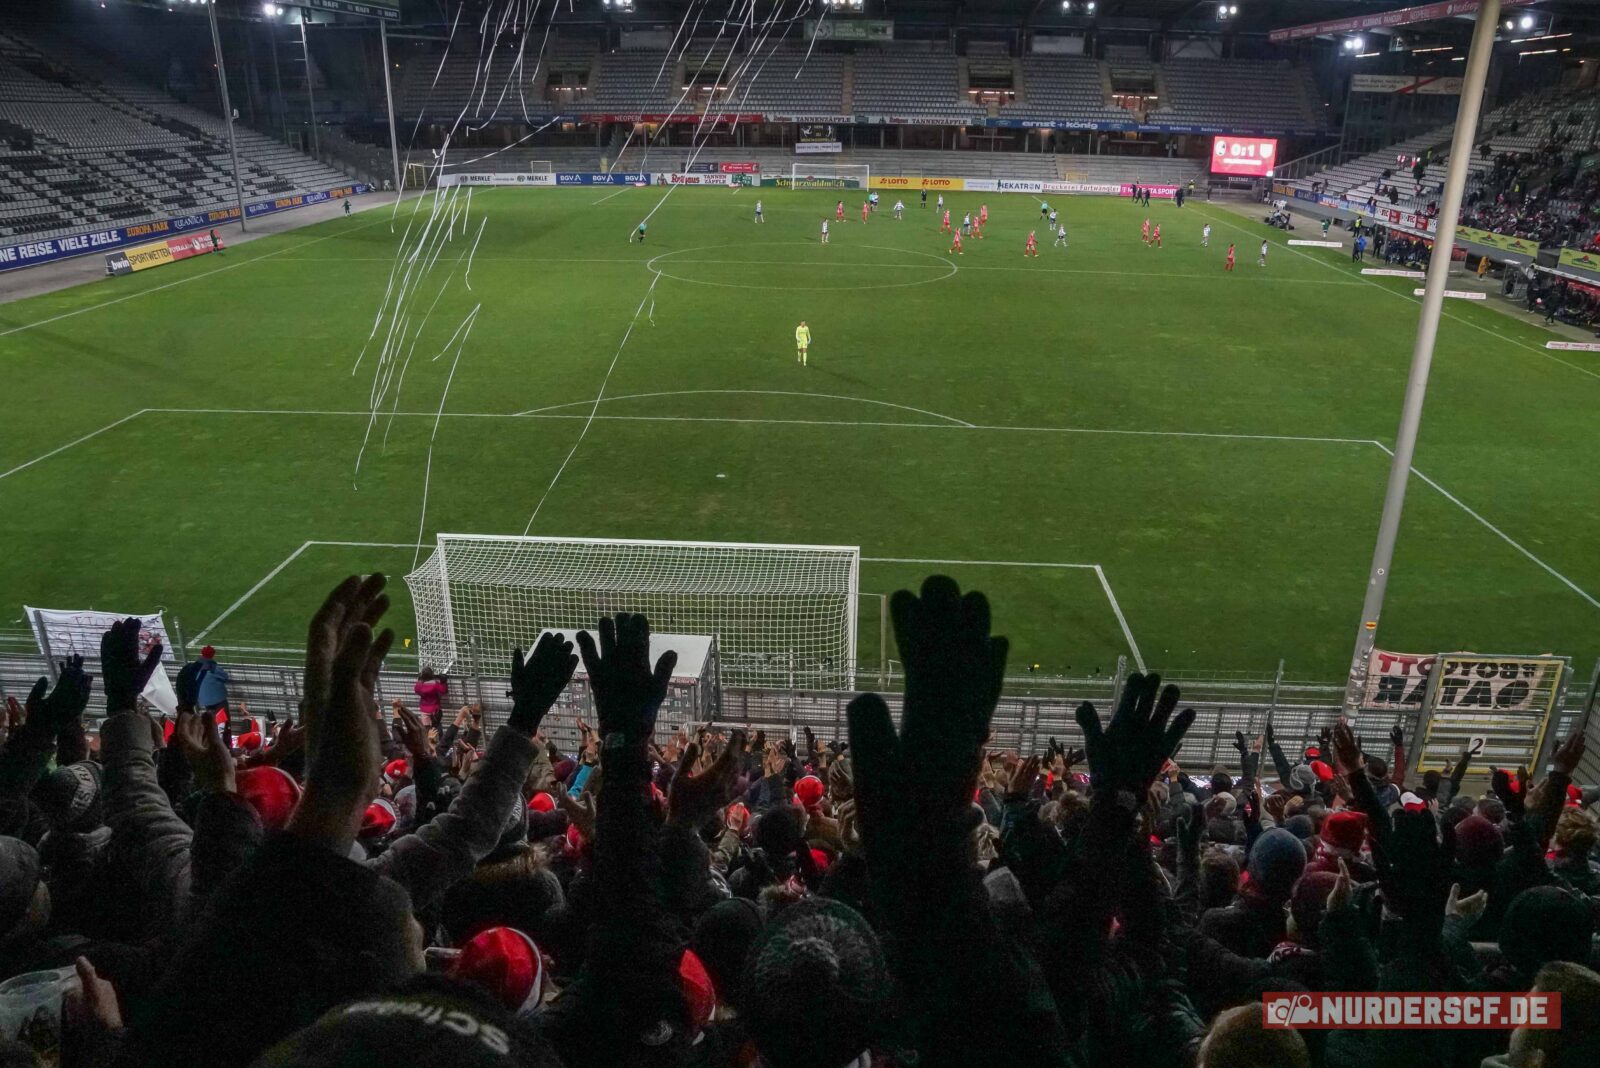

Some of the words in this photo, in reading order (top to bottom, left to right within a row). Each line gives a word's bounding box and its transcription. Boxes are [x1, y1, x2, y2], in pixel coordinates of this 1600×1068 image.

[1066, 121, 1098, 129] könig
[1231, 143, 1255, 157] 0:1
[127, 224, 152, 237] EUROPA
[152, 220, 169, 232] PARK
[18, 241, 57, 259] REISE.
[58, 235, 89, 251] VIELE
[90, 230, 122, 246] ZIELE.
[111, 257, 130, 270] bwin
[128, 249, 171, 265] SPORTWETTEN
[1469, 737, 1484, 756] 2
